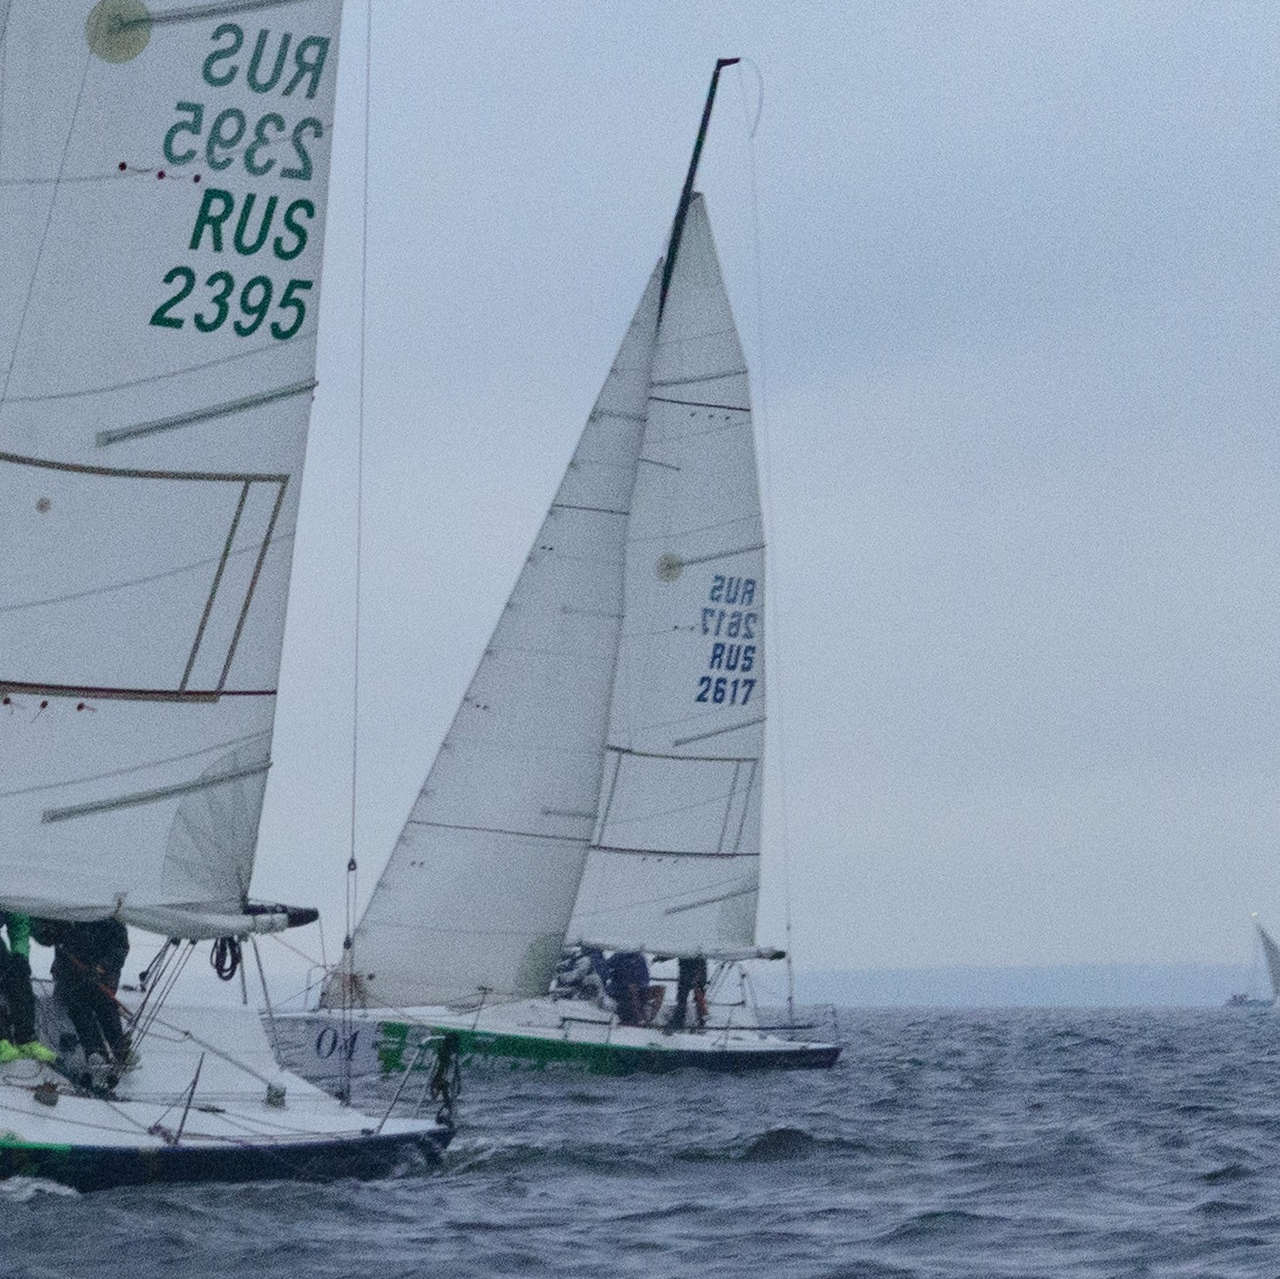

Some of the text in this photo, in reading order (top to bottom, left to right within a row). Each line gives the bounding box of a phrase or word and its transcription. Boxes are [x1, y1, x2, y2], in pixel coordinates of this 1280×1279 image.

[189, 188, 315, 261] RUS
[149, 266, 313, 341] 2395
[709, 643, 756, 671] RUS
[695, 676, 757, 706] 2617
